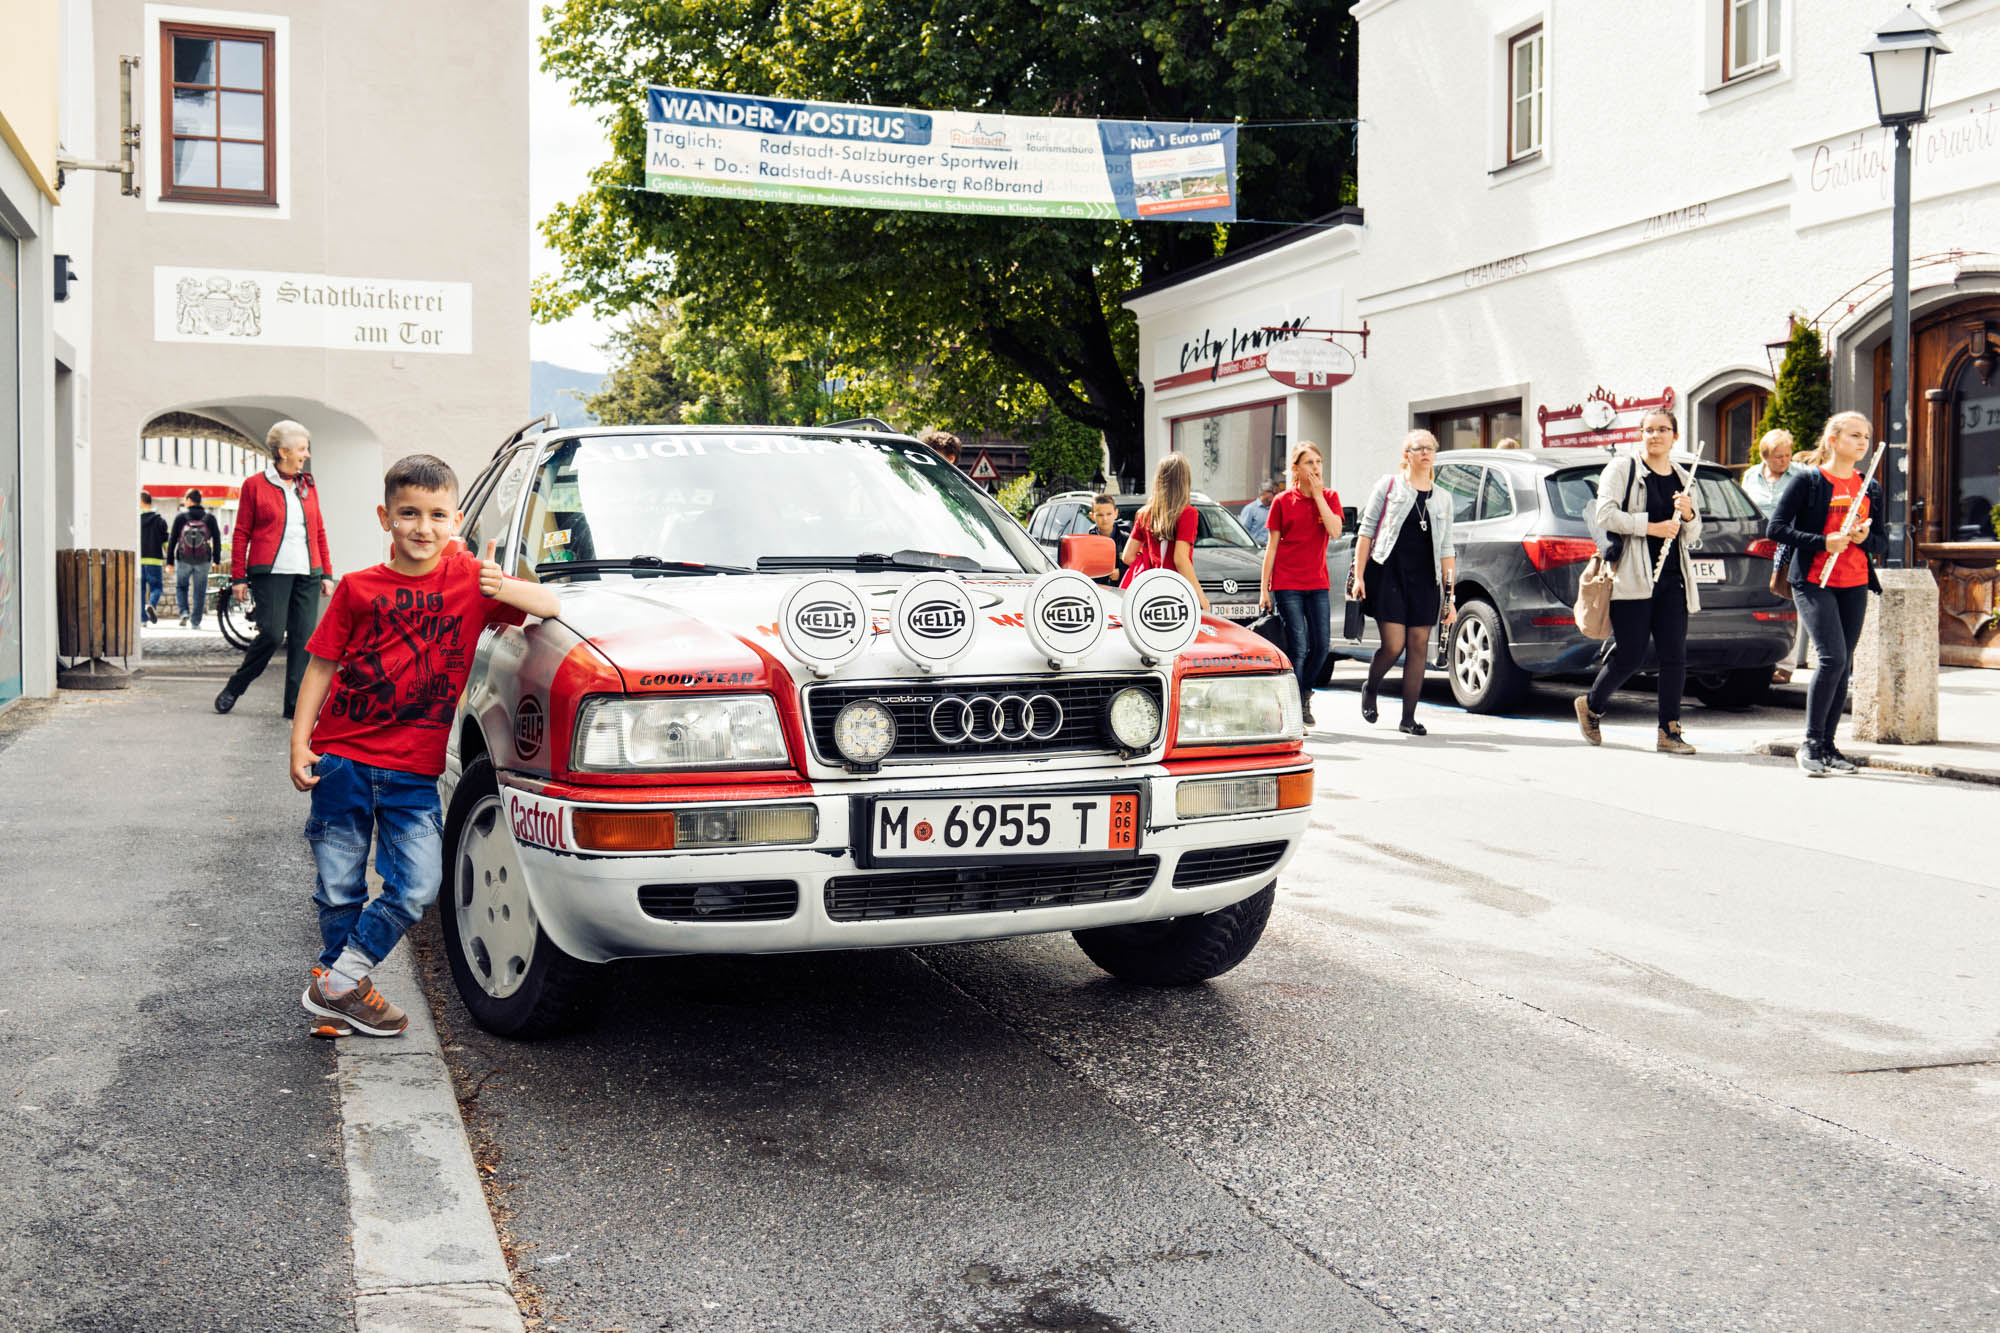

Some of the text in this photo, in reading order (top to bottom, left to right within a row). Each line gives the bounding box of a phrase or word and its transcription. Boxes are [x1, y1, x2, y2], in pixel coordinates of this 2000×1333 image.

[660, 97, 905, 140] WANDER-/POSTBUS
[653, 128, 722, 150] Täglich:
[1130, 129, 1221, 150] Nur 1 Euro mit
[652, 151, 750, 174] Mo. + Do.:
[760, 138, 1018, 171] Radstadt-Salzburger Sportwelt
[759, 161, 1043, 194] Radstadt-Aussichtsberg Roßbrand
[924, 198, 942, 210] bei
[944, 200, 1006, 213] Schuhhaus
[1060, 206, 1085, 216] 45m
[1641, 202, 1709, 241] ZIMMER
[1464, 253, 1529, 288] CHAMBRES
[276, 280, 444, 313] Stadtbäckerei
[354, 321, 444, 346] am Tor
[395, 588, 443, 612] DIG
[801, 610, 856, 629] HELLA
[913, 609, 966, 627] HELLA
[1046, 605, 1095, 623] HELLA
[1143, 604, 1189, 622] HELLA
[420, 615, 463, 647] UP!
[1192, 653, 1273, 668] GOODYEAR
[639, 671, 754, 688] GOODYEAR
[516, 712, 544, 745] HELLA
[1115, 801, 1132, 814] 28
[510, 795, 567, 850] Castrol
[880, 802, 1097, 849] M 6955 T
[1115, 816, 1131, 828] 06
[1116, 831, 1130, 843] 16
